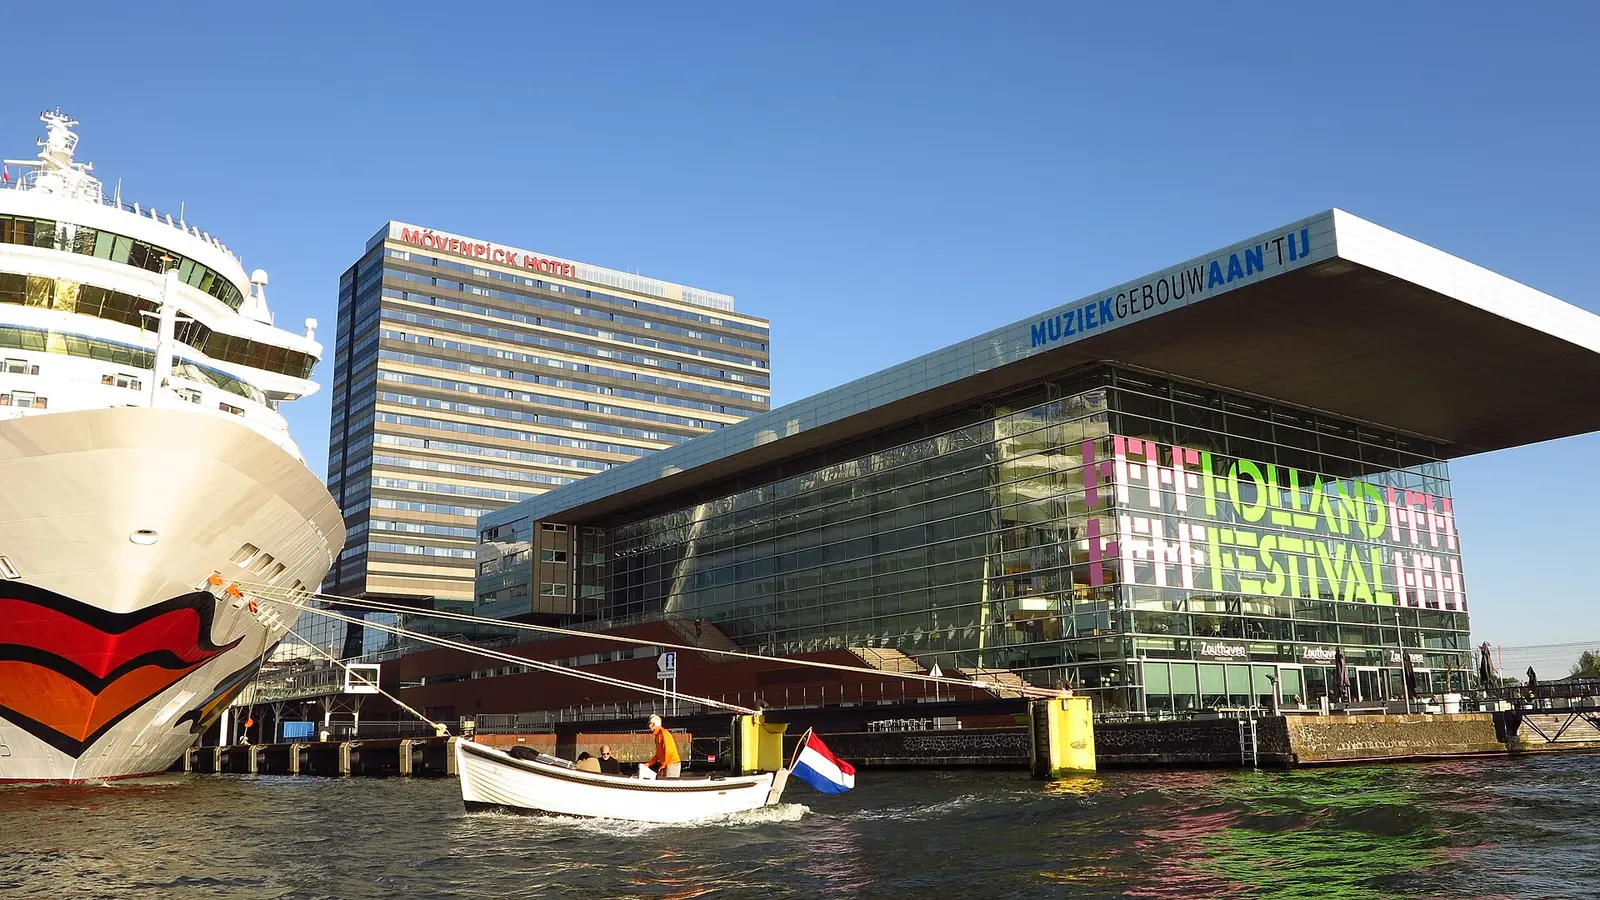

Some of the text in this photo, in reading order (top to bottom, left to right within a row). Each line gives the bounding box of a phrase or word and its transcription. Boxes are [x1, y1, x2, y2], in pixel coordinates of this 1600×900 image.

[523, 254, 578, 279] HOTEL
[1201, 451, 1387, 540] HOLLAND
[1207, 527, 1393, 606] FESTIVAL
[1200, 641, 1247, 657] Zouthaven
[1302, 645, 1337, 660] Zouthave
